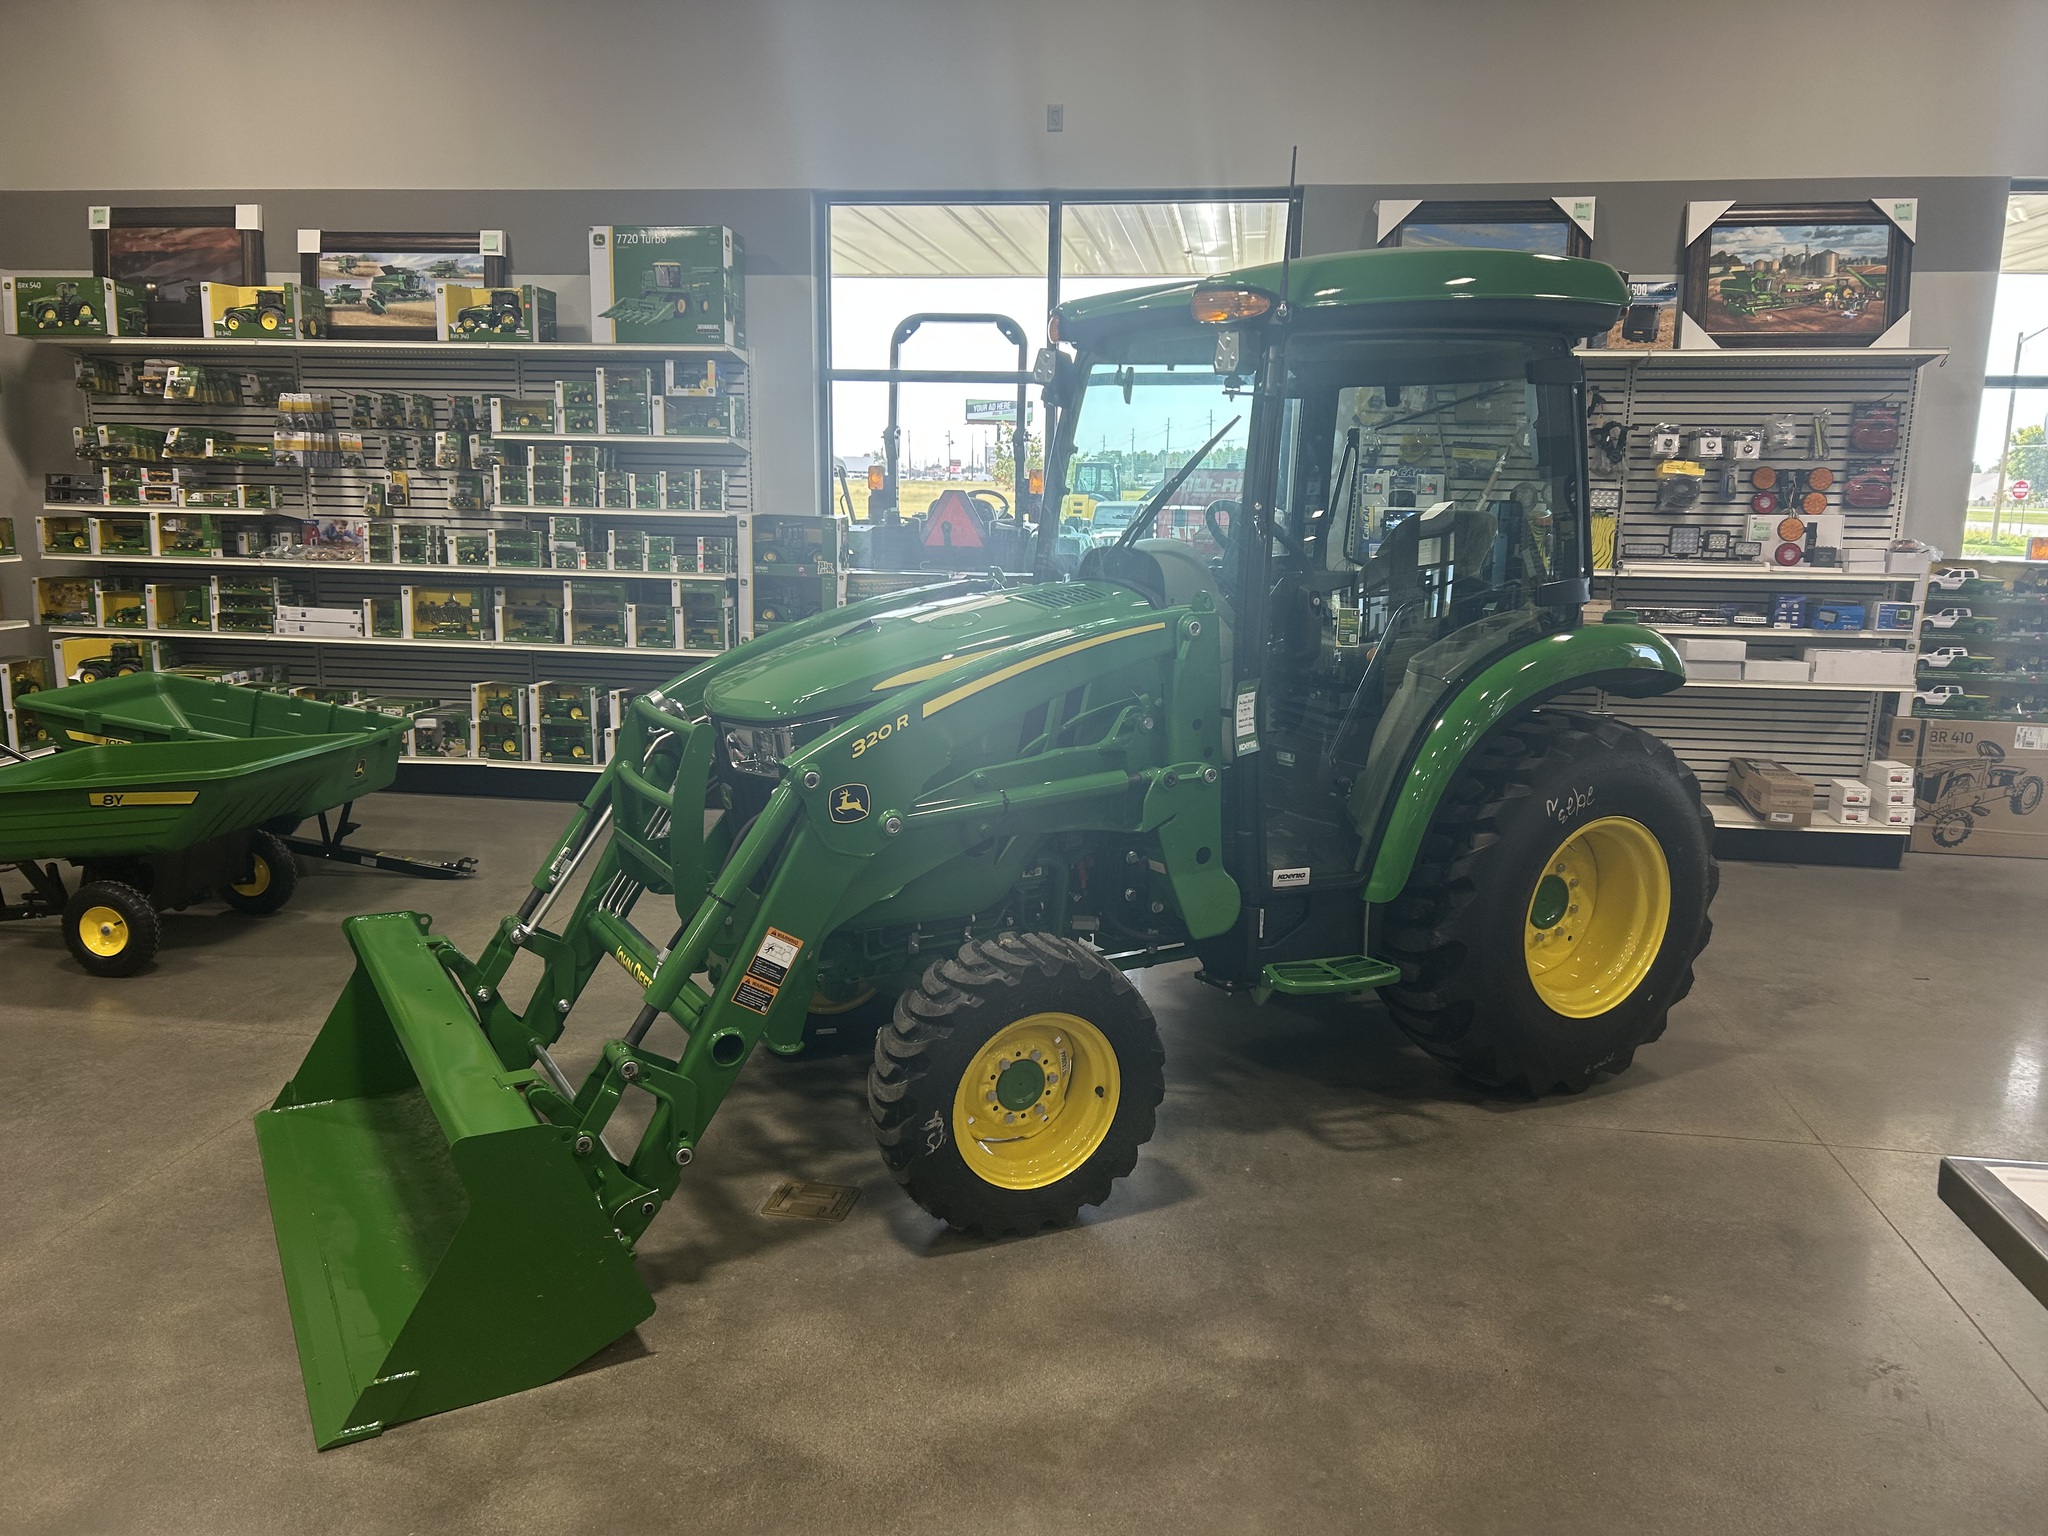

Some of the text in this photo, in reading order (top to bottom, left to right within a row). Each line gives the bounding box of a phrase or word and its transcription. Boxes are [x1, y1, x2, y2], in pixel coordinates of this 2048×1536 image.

[616, 234, 667, 244] 7720 Turbo
[29, 281, 41, 289] 540
[973, 401, 1012, 412] YOUR AD HERE
[818, 561, 833, 569] Big
[852, 713, 909, 758] 320 R
[1930, 730, 1974, 744] 8R 410
[103, 794, 124, 806] 8Y
[776, 932, 799, 945] WARNING
[615, 945, 634, 974] JOHN
[751, 981, 774, 994] WARNING
